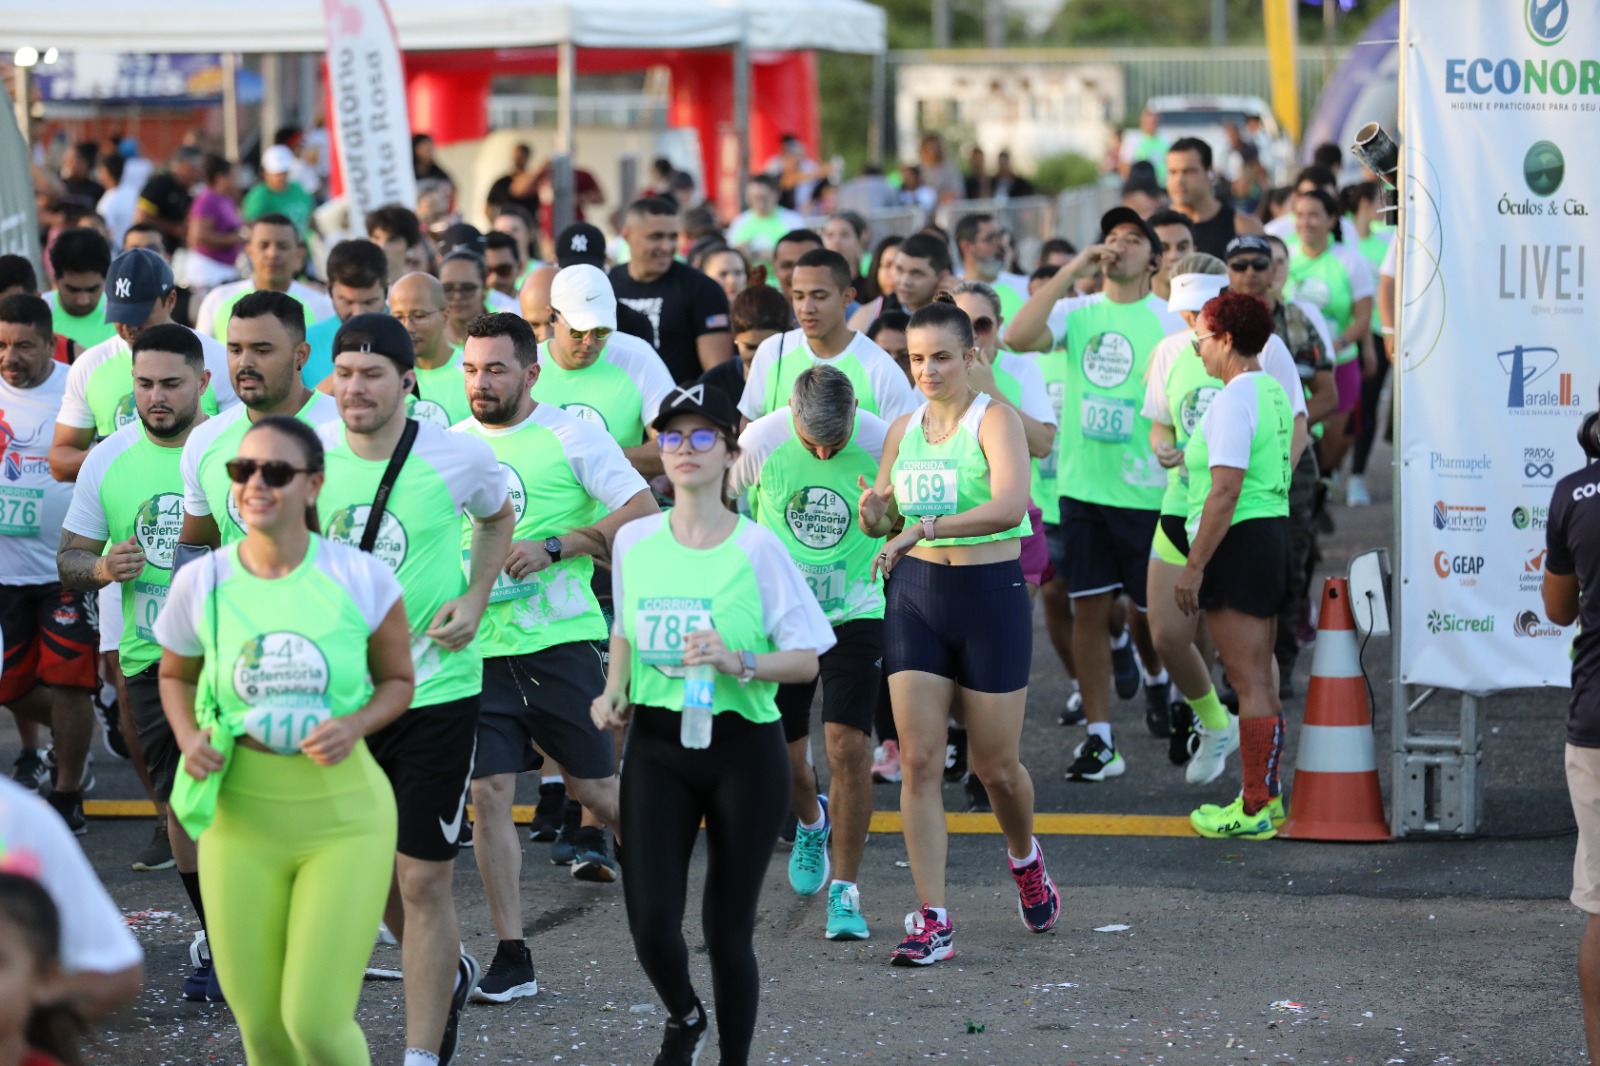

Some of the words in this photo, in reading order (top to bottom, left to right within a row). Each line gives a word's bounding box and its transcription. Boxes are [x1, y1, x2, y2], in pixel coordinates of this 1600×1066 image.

[1451, 102, 1483, 111] HIGIENE
[1486, 102, 1491, 111] E
[1493, 102, 1547, 111] PRATICIDADE
[1549, 103, 1569, 112] PARA
[1572, 103, 1577, 111] O
[1580, 103, 1596, 112] SEU
[1497, 192, 1543, 216] Óculos
[1547, 200, 1558, 215] &
[1563, 198, 1589, 216] Cia.
[1499, 244, 1585, 300] LIVE!
[115, 277, 131, 298] NY
[1087, 404, 1123, 433] 036
[1430, 451, 1492, 473] Pharmapele
[1523, 447, 1555, 459] PRADO
[903, 461, 945, 470] CORRIDA
[904, 473, 945, 503] 169
[790, 511, 846, 524] Defensoria
[1433, 501, 1487, 530] Norberto
[806, 523, 843, 535] Pública
[1452, 556, 1484, 574] GEAP
[644, 599, 704, 611] CORRIDA
[1443, 613, 1495, 632] Sicredi
[1527, 621, 1561, 638] Gavião
[645, 615, 701, 650] 785
[240, 668, 323, 684] Defensoria
[1217, 820, 1241, 833] FILA
